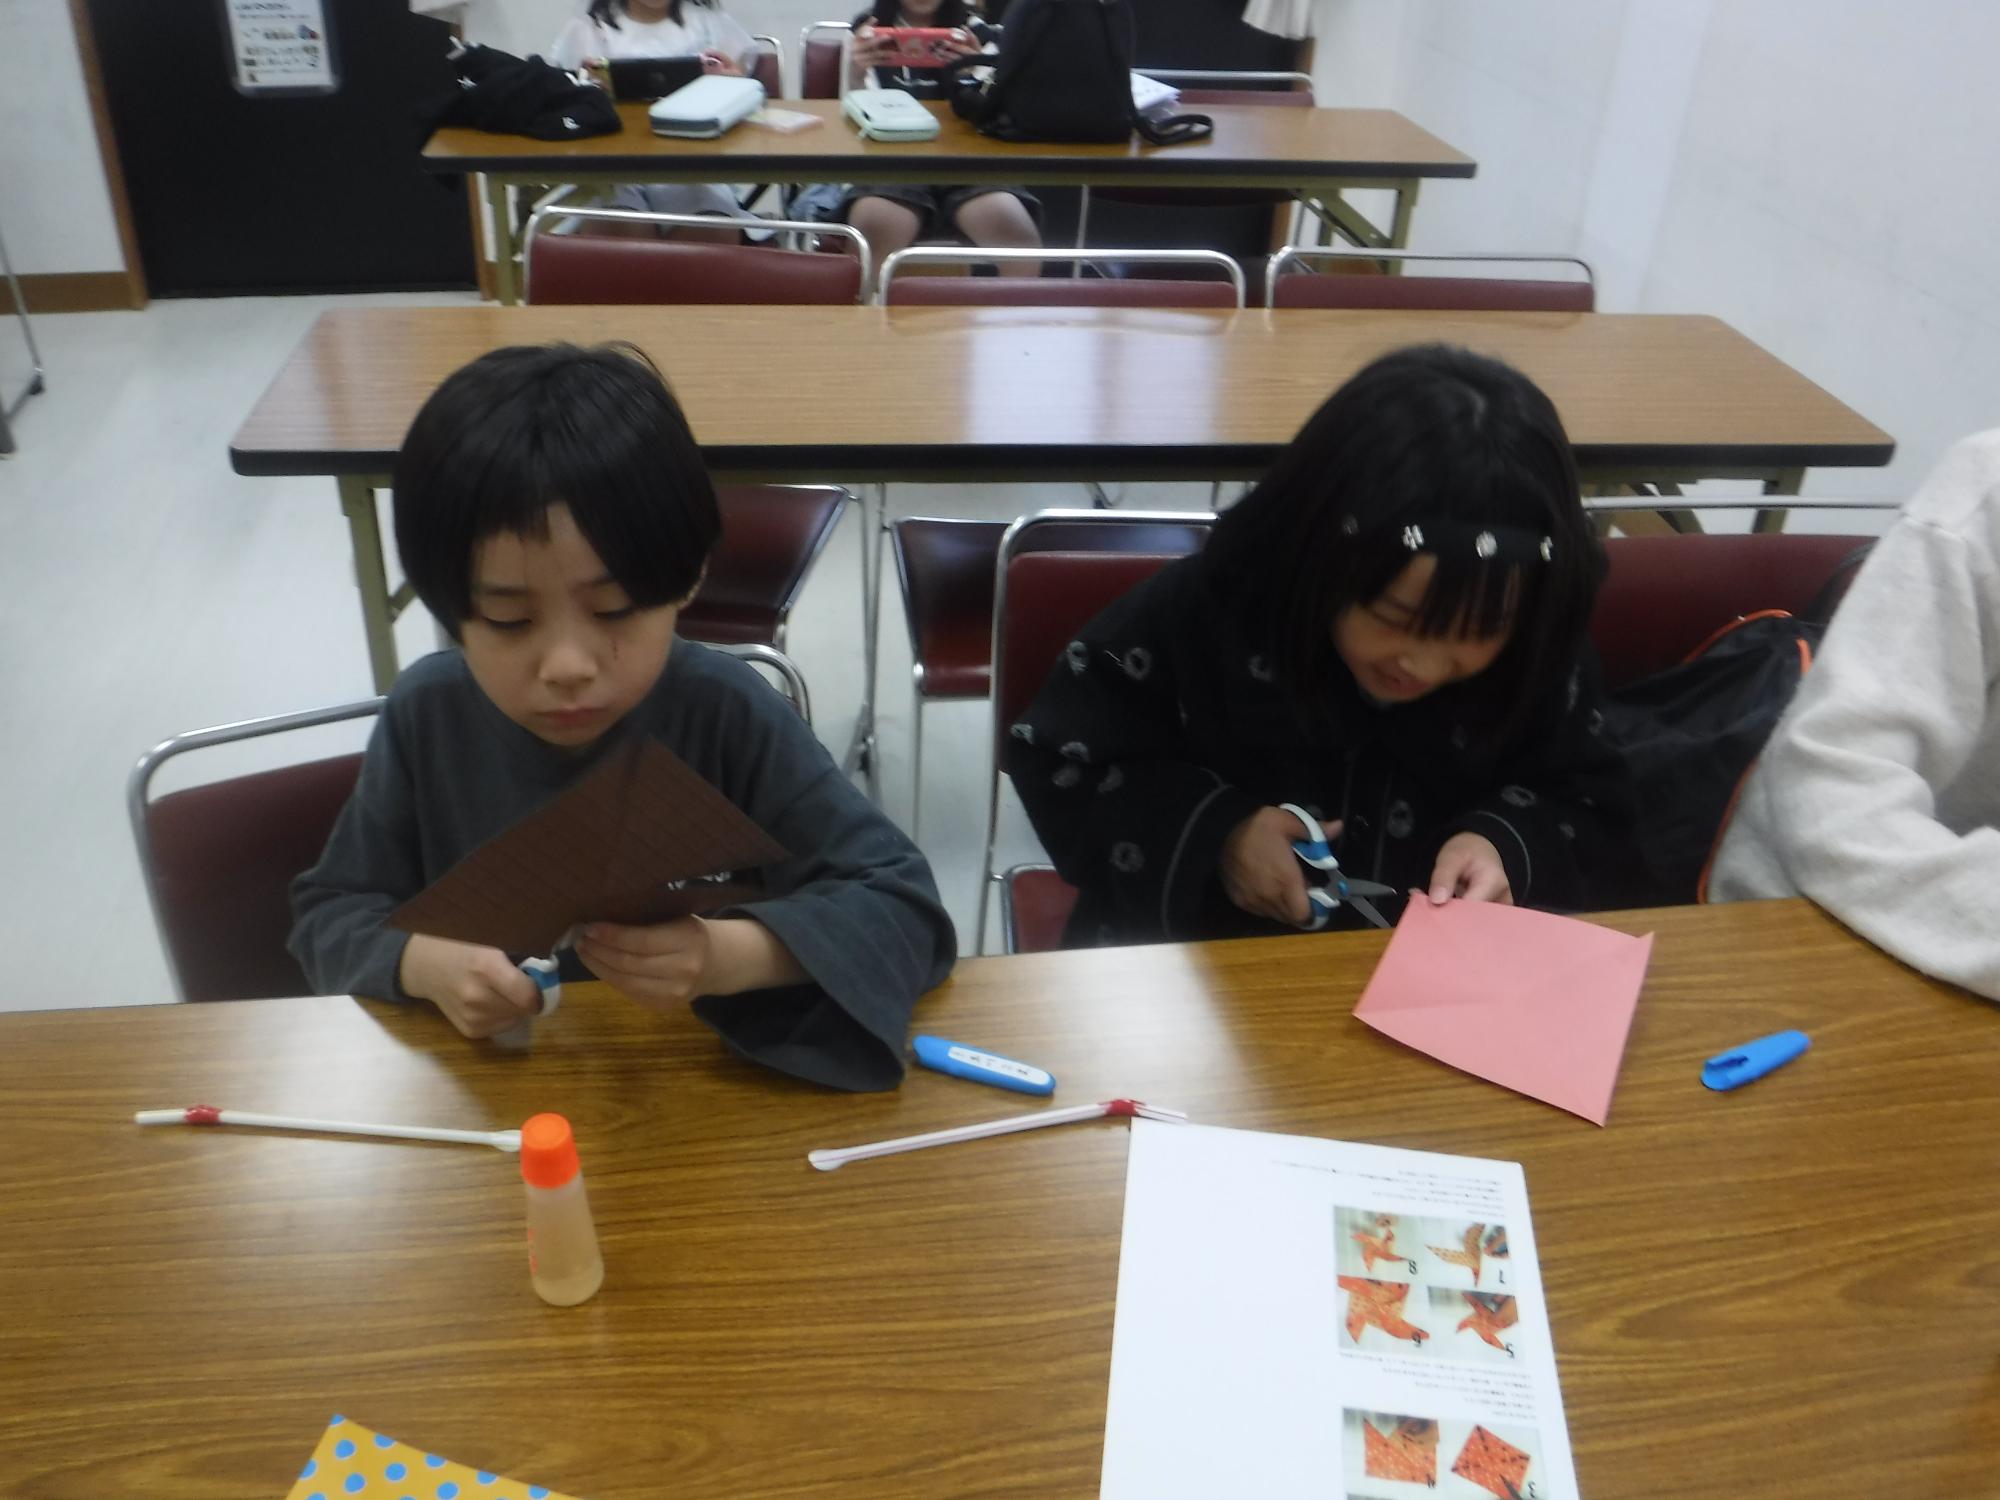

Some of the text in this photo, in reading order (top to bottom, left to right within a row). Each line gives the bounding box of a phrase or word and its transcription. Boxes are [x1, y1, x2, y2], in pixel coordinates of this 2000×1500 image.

[1408, 1259, 1418, 1276] 8
[1411, 1330, 1422, 1348] 6
[1505, 1342, 1515, 1359] 5
[1527, 1480, 1537, 1499] 3
